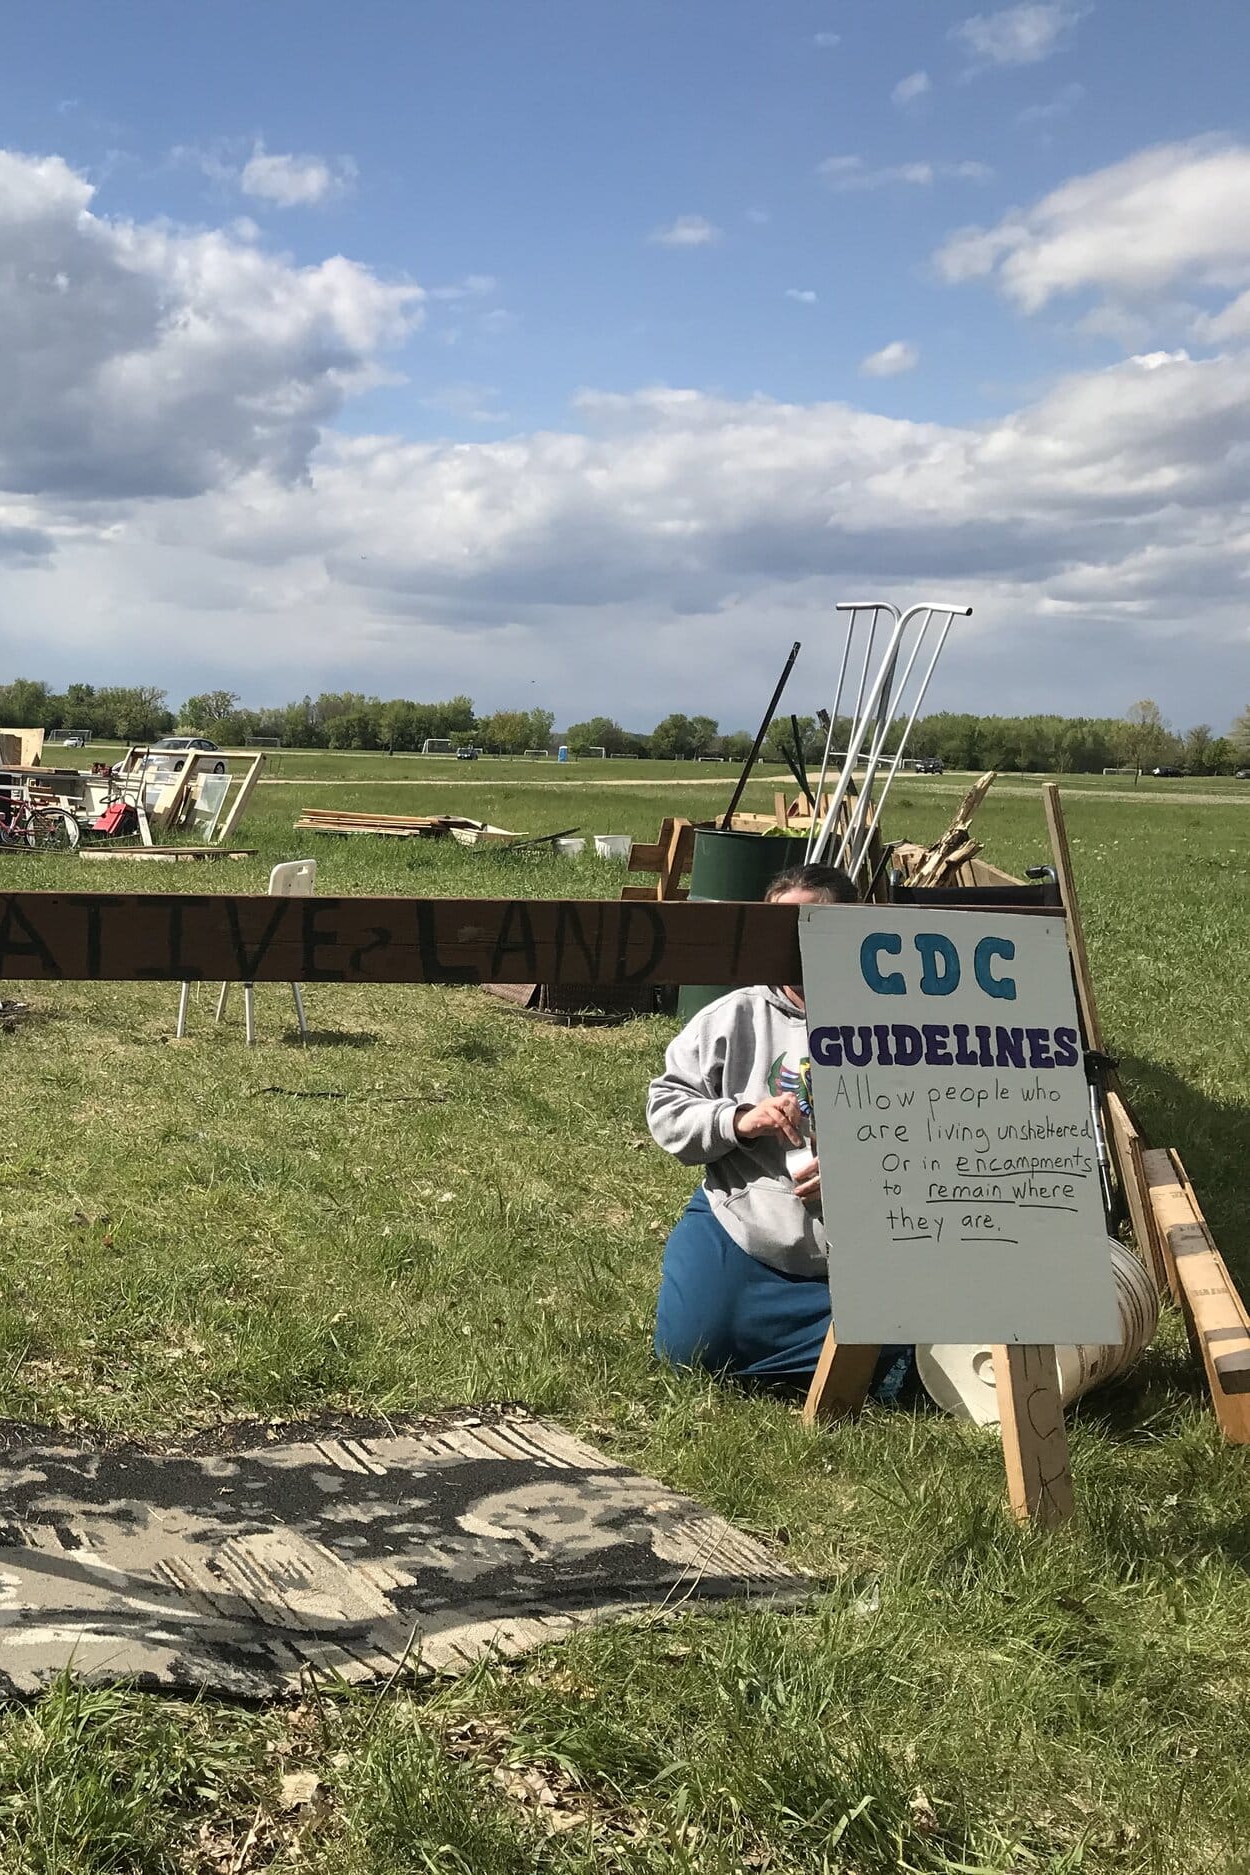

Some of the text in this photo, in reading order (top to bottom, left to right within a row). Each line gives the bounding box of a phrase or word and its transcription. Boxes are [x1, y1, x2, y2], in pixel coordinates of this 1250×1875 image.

[416, 900, 666, 985] LAND
[860, 932, 1017, 1000] CDC
[808, 1023, 1080, 1069] GUIDELINES
[834, 1075, 1062, 1121] Allow people who
[856, 1123, 910, 1144] are
[926, 1122, 991, 1154] living
[881, 1147, 1093, 1176] Or in encampments
[882, 1179, 1076, 1200] to remain where
[886, 1208, 1002, 1243] they are.
